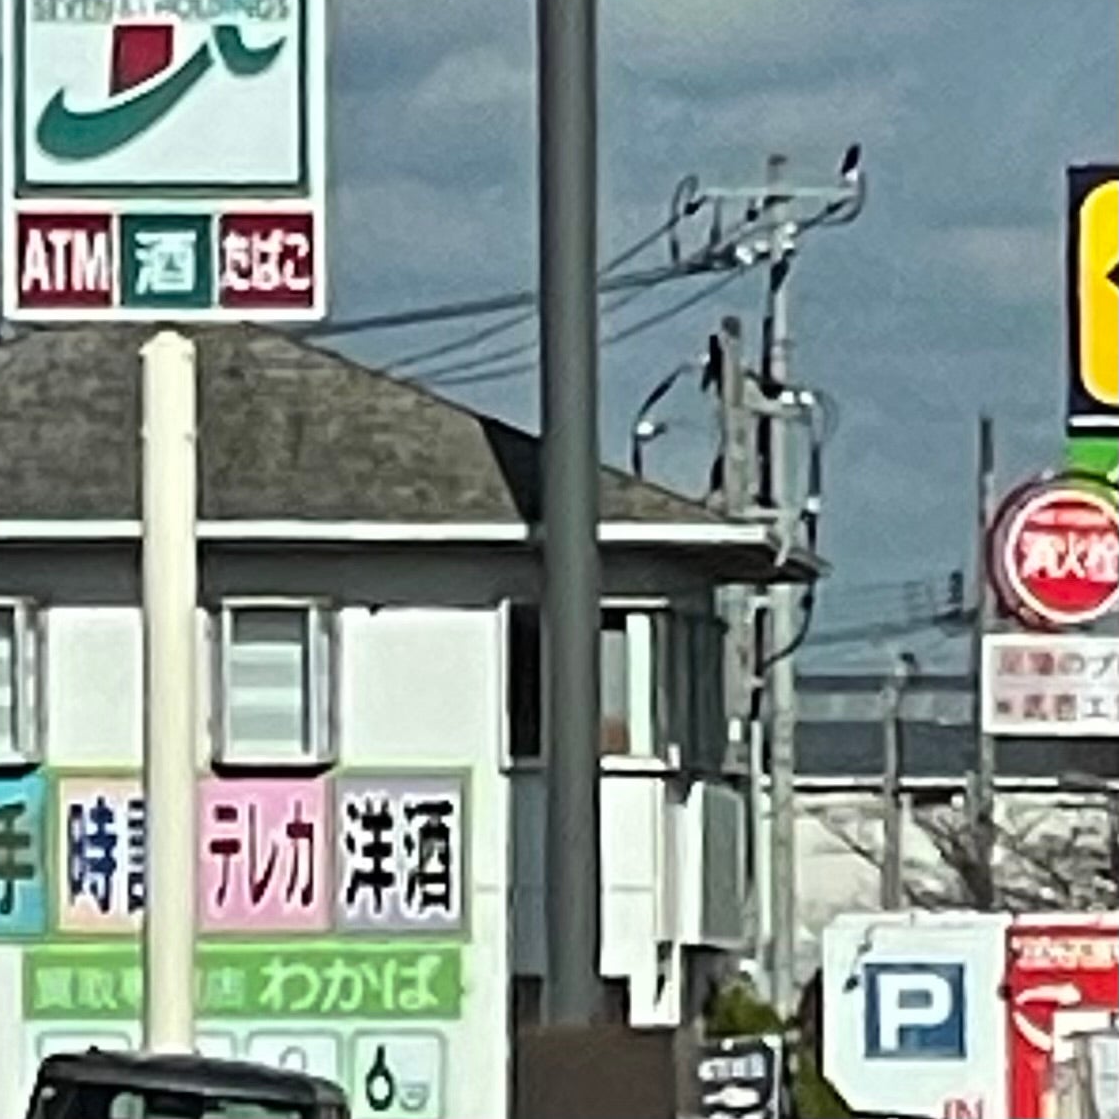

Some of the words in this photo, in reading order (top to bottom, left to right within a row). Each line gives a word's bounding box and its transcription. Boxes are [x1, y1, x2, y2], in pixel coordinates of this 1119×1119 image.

[21, 229, 109, 291] ATM
[135, 232, 197, 294] 酒
[223, 229, 311, 291] たばこ
[210, 800, 315, 907] テレカ
[346, 796, 454, 915] 洋酒
[260, 955, 442, 1012] わかば
[880, 974, 952, 1051] P
